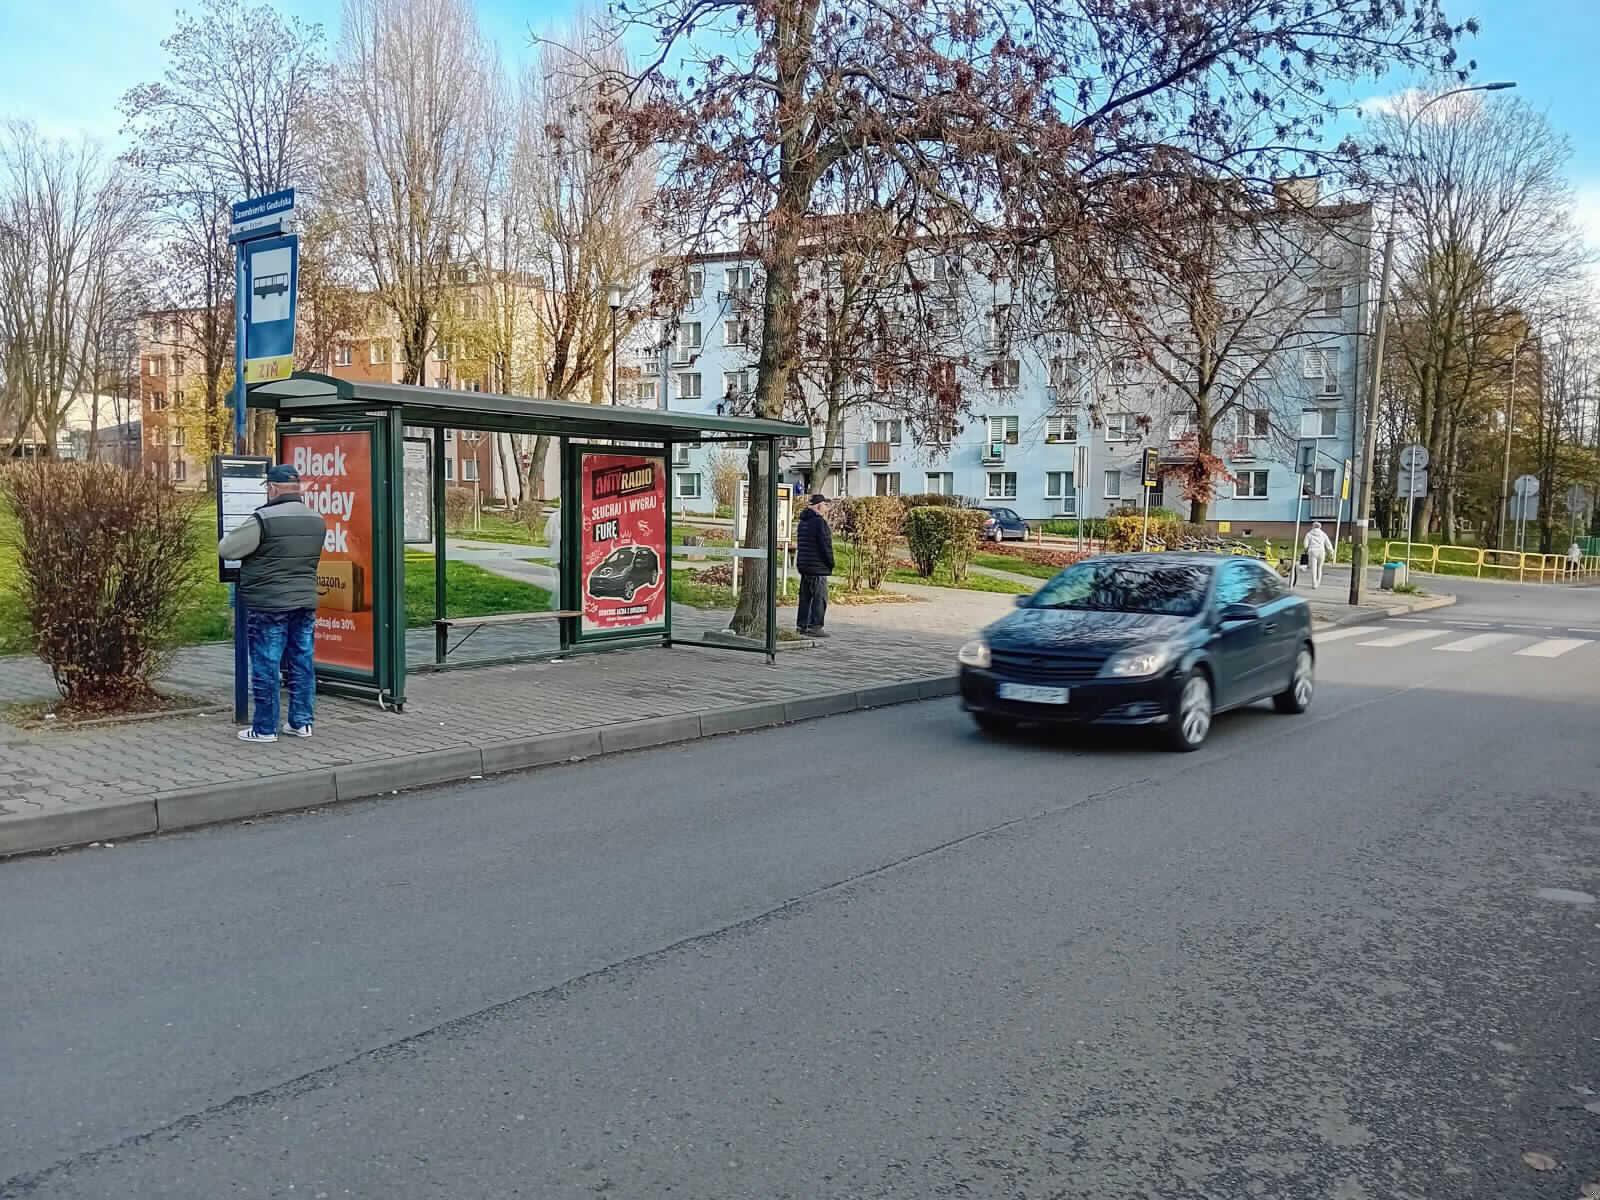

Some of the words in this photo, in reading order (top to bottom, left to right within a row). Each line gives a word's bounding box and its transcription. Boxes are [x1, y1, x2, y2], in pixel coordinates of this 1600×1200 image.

[294, 446, 347, 476] Black
[592, 502, 622, 520] SŁUCHAJ
[623, 500, 628, 513] I
[629, 495, 657, 513] WYGRAJ
[323, 522, 348, 552] ek
[595, 520, 618, 541] FURĘ
